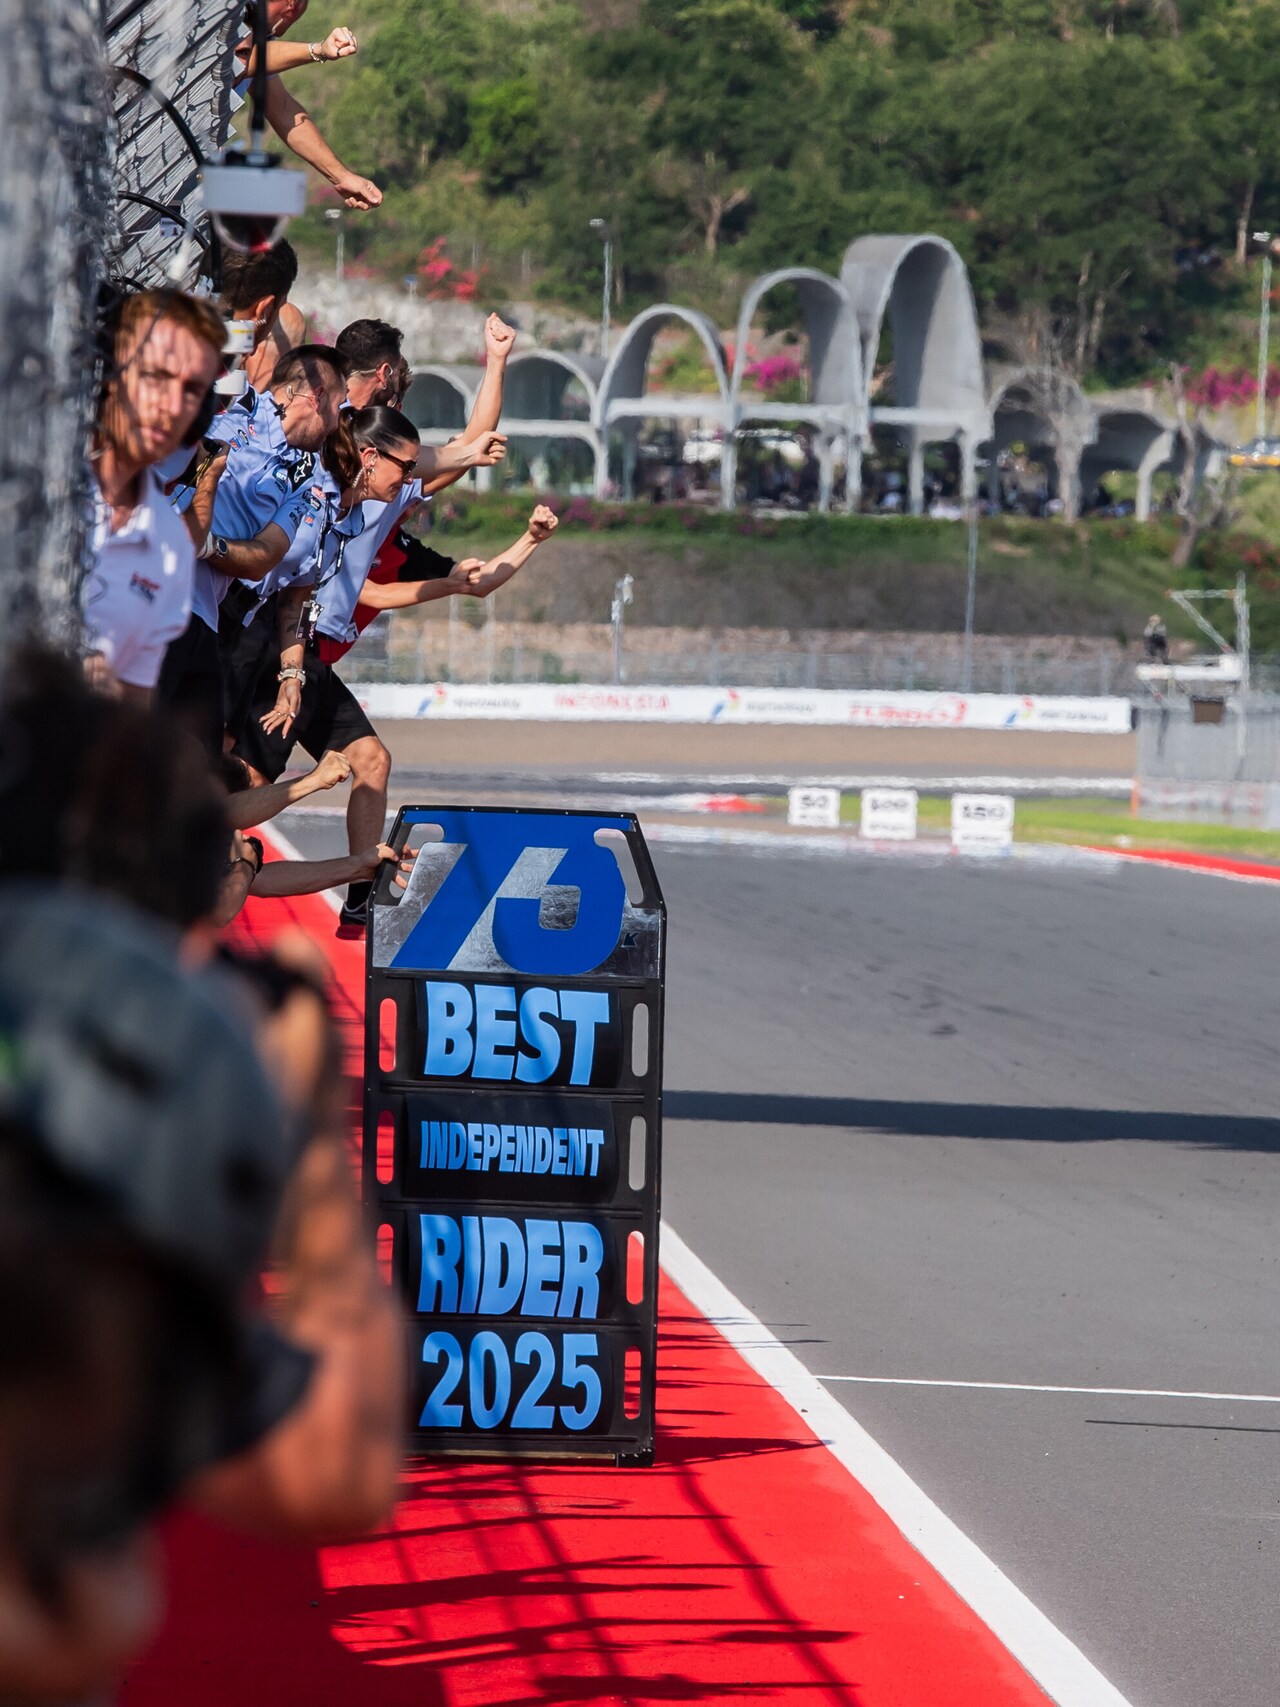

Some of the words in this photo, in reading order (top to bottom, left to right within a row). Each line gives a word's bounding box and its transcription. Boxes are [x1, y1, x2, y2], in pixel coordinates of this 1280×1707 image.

[424, 980, 610, 1086] BEST
[419, 1120, 605, 1177] INDEPENDENT
[416, 1213, 605, 1319] RIDER
[418, 1330, 603, 1431] 2025
